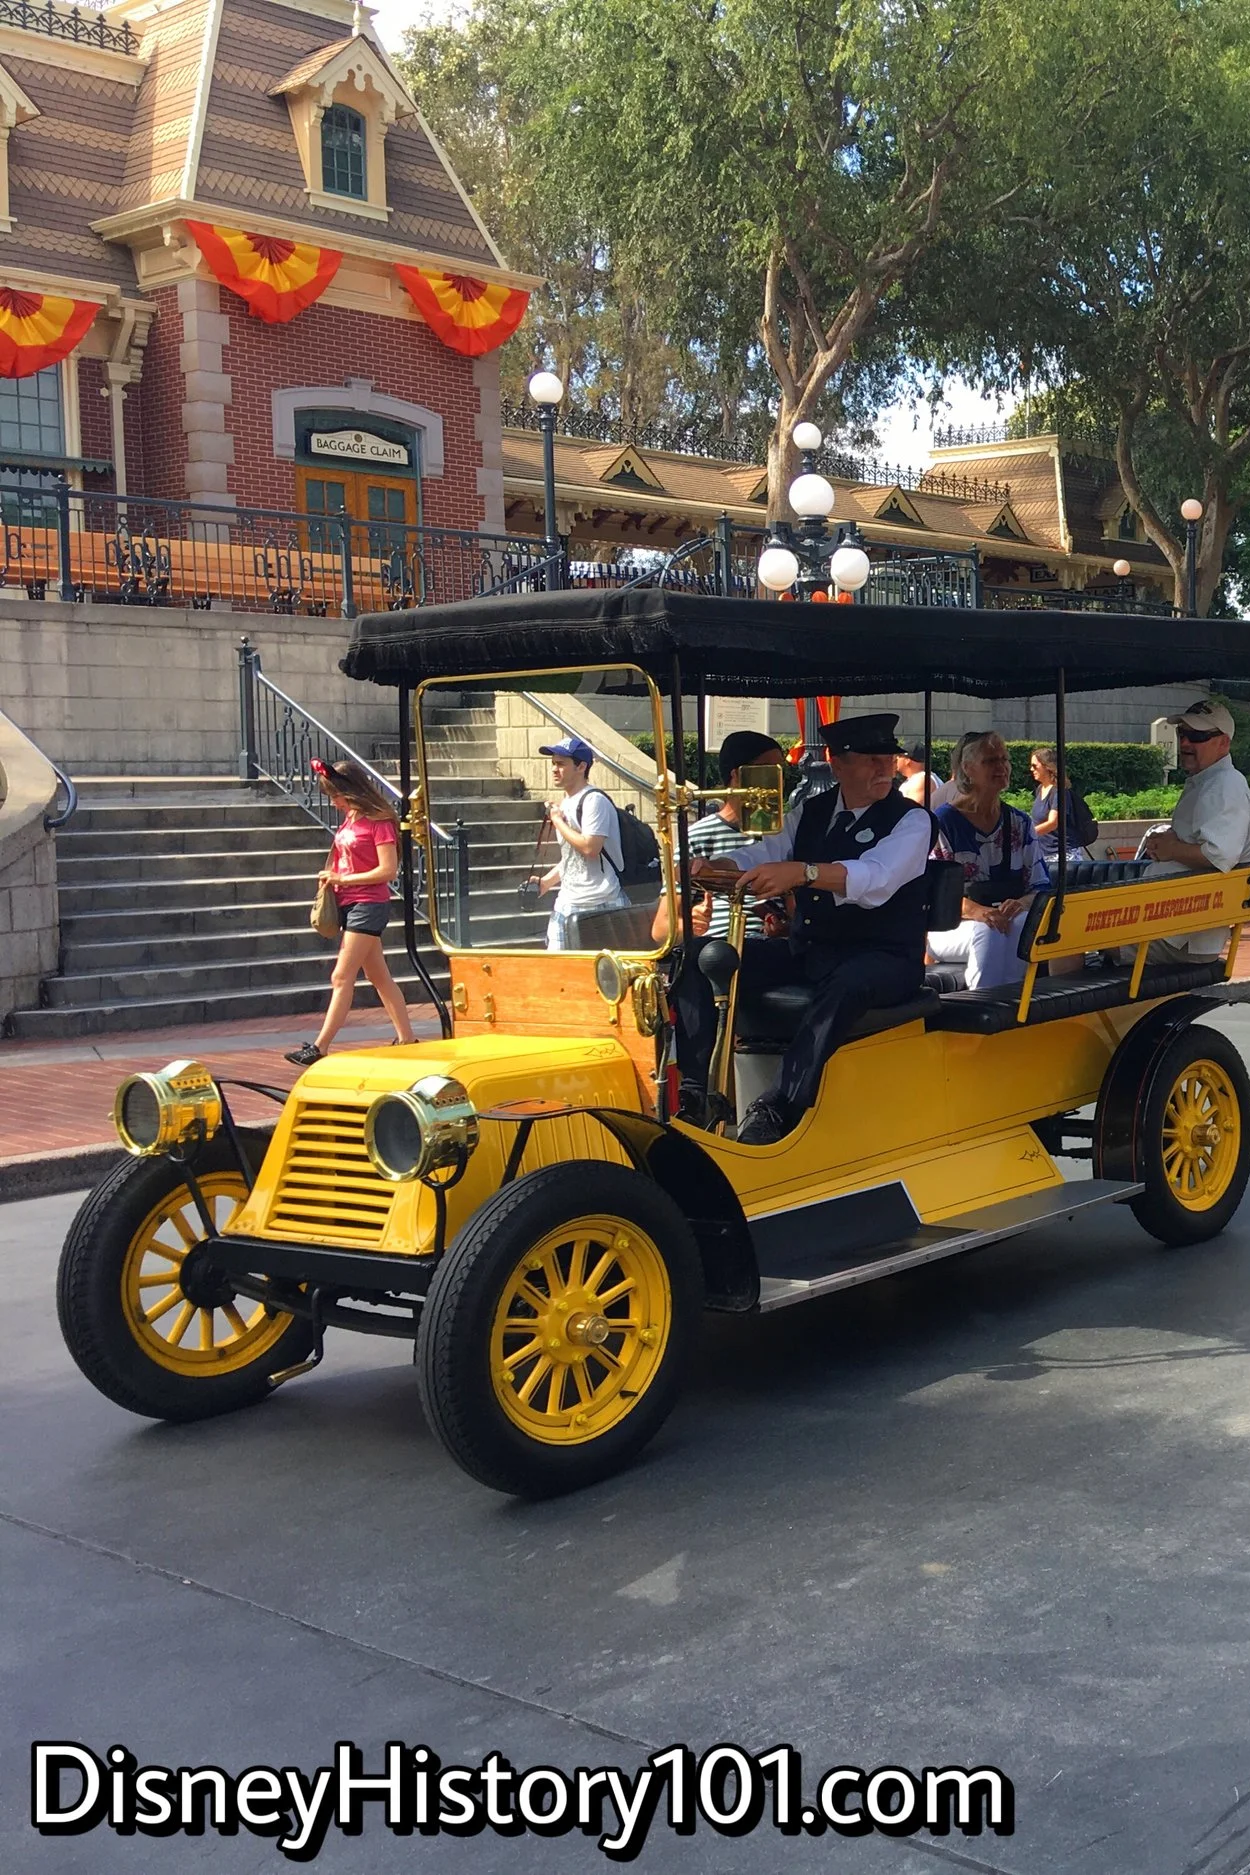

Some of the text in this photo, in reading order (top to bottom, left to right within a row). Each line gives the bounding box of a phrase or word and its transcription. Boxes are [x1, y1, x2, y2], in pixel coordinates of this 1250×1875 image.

[316, 438, 402, 459] BAGGAGE CLAIM
[1085, 904, 1141, 932] DISNEYLAND
[1143, 893, 1212, 921] TRANSPORTATION
